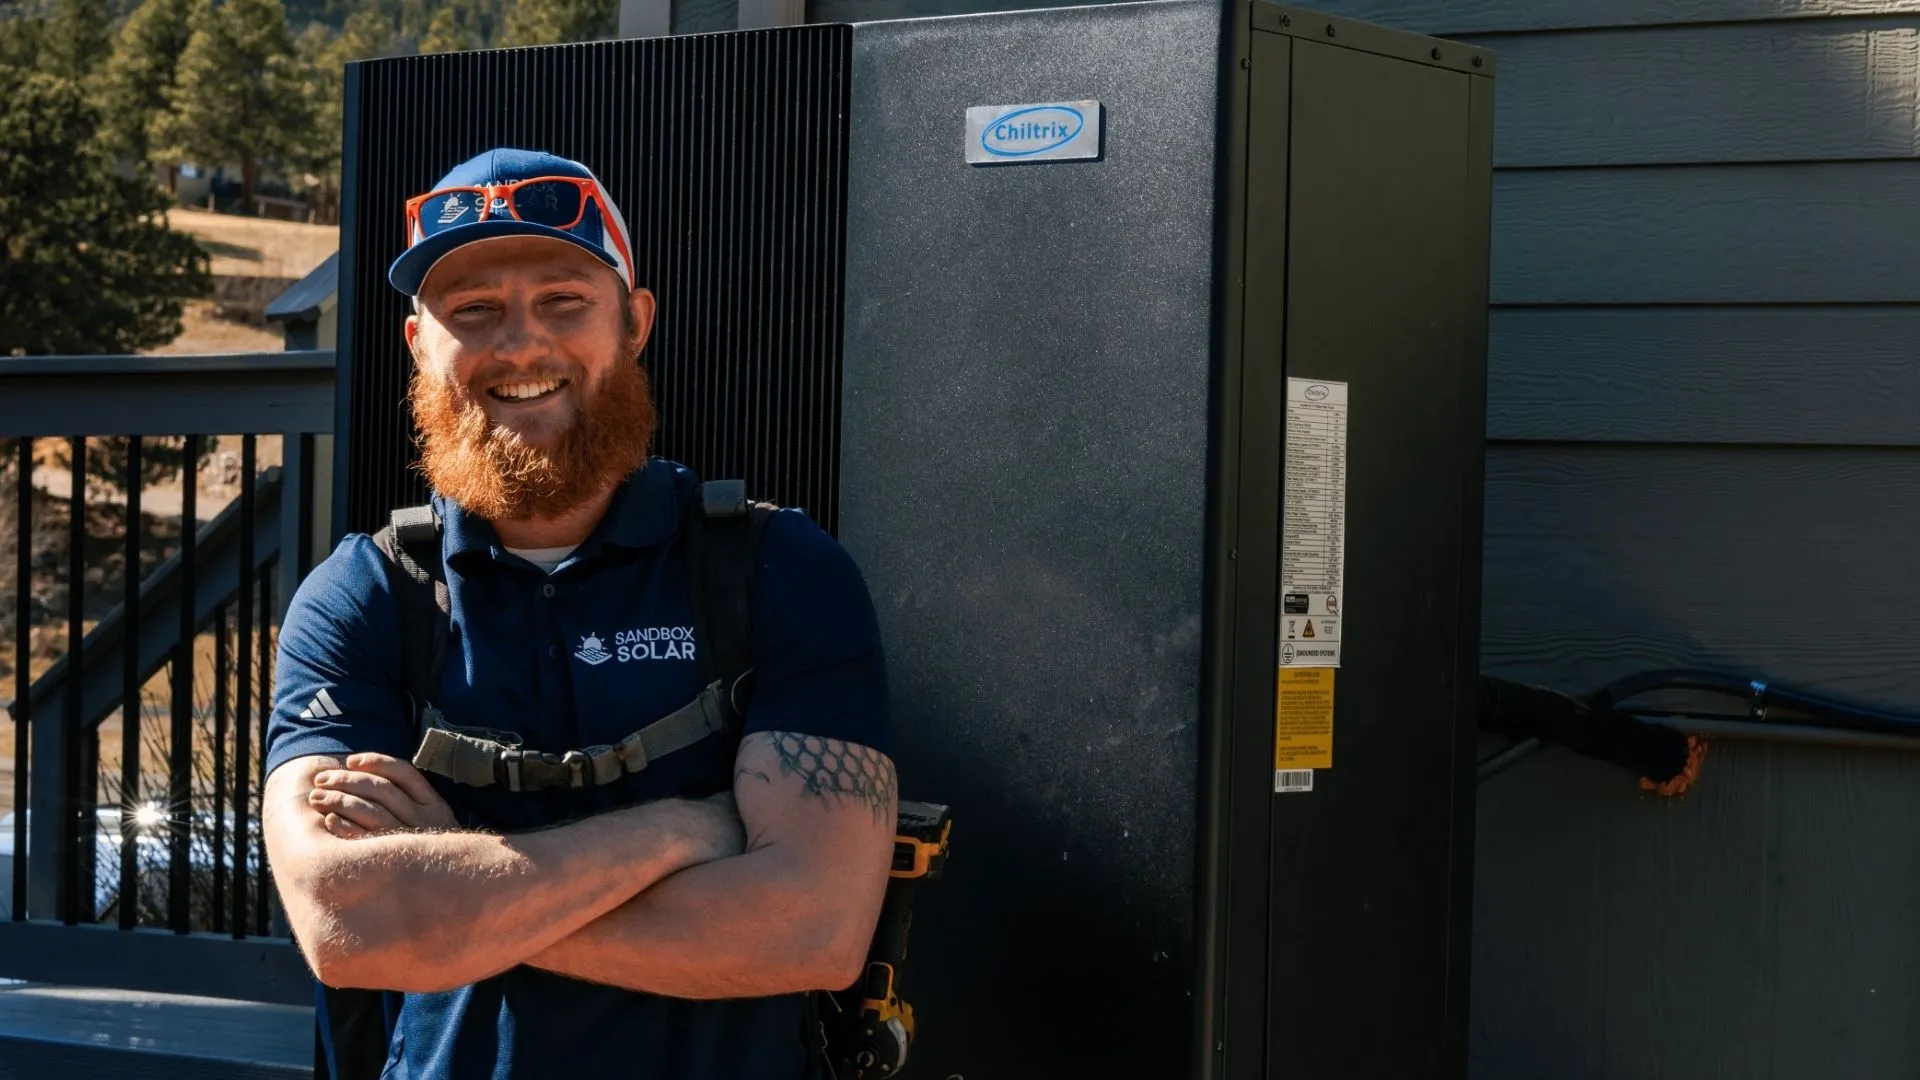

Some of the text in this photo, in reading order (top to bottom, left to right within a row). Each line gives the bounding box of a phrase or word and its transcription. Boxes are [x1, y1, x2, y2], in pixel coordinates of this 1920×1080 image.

[995, 121, 1068, 141] Chiltrix
[474, 192, 560, 212] SOAR
[615, 626, 696, 645] SANDBOX
[617, 640, 696, 662] SOLAR
